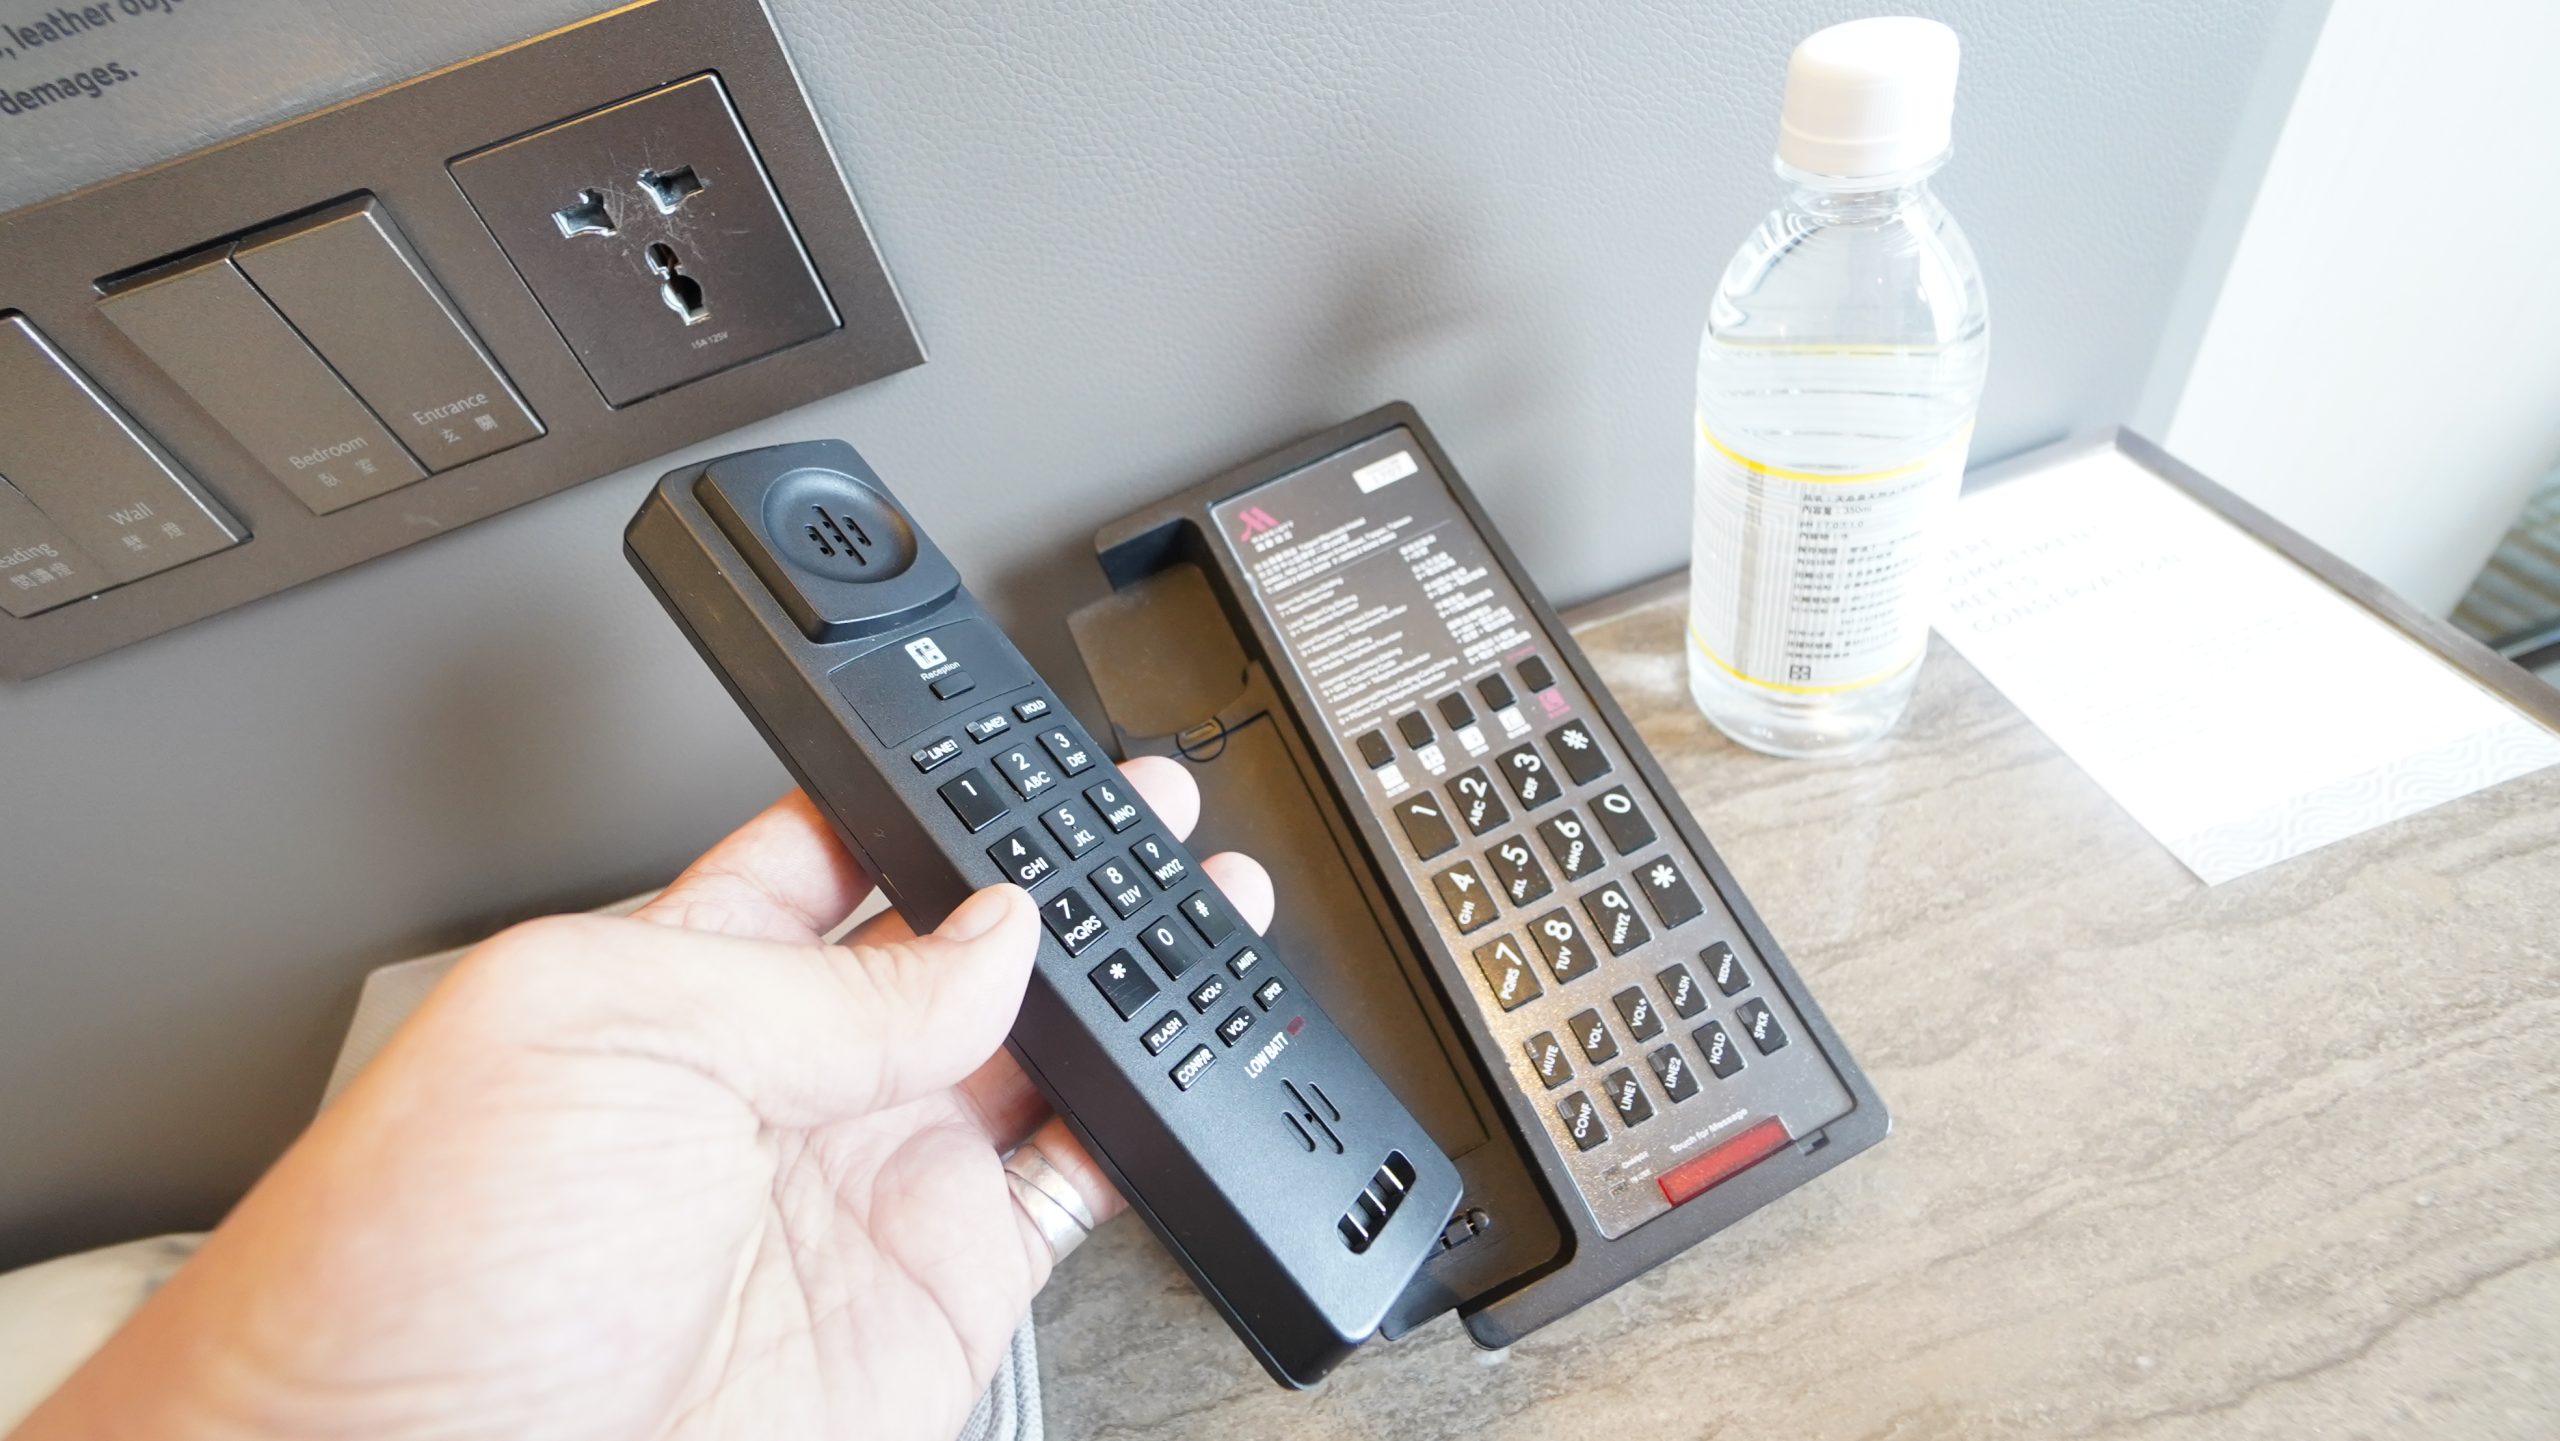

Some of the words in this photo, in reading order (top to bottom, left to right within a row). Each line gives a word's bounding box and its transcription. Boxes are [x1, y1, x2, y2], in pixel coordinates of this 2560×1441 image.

[2, 2, 117, 50] leather
[0, 61, 139, 116] demages.
[412, 393, 489, 425] Entrance
[288, 437, 368, 470] Bedroom
[108, 501, 155, 526] Wall
[0, 543, 59, 568] eading
[920, 661, 961, 682] Reception
[1021, 700, 1047, 715] HOLD
[980, 716, 1009, 734] LINE2
[927, 739, 959, 760] LINE1
[1054, 732, 1071, 748] 3
[1562, 729, 1589, 750] #
[1012, 752, 1031, 771] 2
[1066, 751, 1089, 768] DEF
[1513, 752, 1541, 772] 3
[961, 780, 977, 797] 1
[1024, 771, 1051, 792] ABC
[1459, 777, 1487, 798] 2
[1522, 777, 1540, 800] DEF
[1101, 786, 1115, 803] 6
[1603, 793, 1632, 814] 0
[1058, 808, 1076, 826] 5
[1109, 804, 1136, 825] MNO
[1411, 805, 1437, 817] 1
[1469, 800, 1486, 826] ABC
[1073, 829, 1095, 848] JKL
[1554, 819, 1581, 838] 6
[1011, 838, 1027, 856] 4
[1145, 842, 1160, 859] 9
[1501, 844, 1529, 866] 5
[1566, 840, 1584, 872] MNO
[1020, 857, 1049, 880] GHI
[1106, 867, 1124, 885] 8
[1154, 859, 1184, 881] WXYZ
[1449, 872, 1475, 892] 4
[1512, 879, 1528, 899] JKL
[1117, 885, 1142, 907] TUV
[1602, 890, 1630, 910] 9
[1056, 898, 1072, 920] 7
[1195, 900, 1211, 918] #
[1458, 901, 1476, 925] GHI
[1064, 915, 1102, 948] PQRS
[1157, 928, 1175, 946] 0
[1544, 919, 1573, 942] 8
[1612, 912, 1631, 945] WXYZ
[1236, 951, 1258, 971] MUTE
[1495, 942, 1522, 966] 7
[1555, 946, 1573, 971] TUV
[1718, 953, 1734, 985] REDIAL
[1198, 982, 1223, 1003] VOL+
[1263, 982, 1283, 1001] SPKR
[1500, 968, 1520, 1000] PQRS
[1675, 975, 1691, 1006] FLASH
[1632, 998, 1648, 1028] VOL+
[1150, 1017, 1183, 1047] FLASH
[1226, 1014, 1251, 1036] VOL-
[1754, 1011, 1770, 1040] SPKR
[1244, 1051, 1271, 1079] LOW
[1263, 1031, 1289, 1060] BATT
[1710, 1031, 1726, 1065] HOLD
[1177, 1049, 1213, 1083] CONF/R
[1542, 1044, 1559, 1076] MUTE
[1665, 1056, 1682, 1088] LINE2
[1620, 1080, 1637, 1111] LINE1
[1574, 1102, 1592, 1139] CONF
[1669, 1135, 1698, 1153] Touch
[1696, 1128, 1710, 1140] for
[1708, 1108, 1749, 1133] Message
